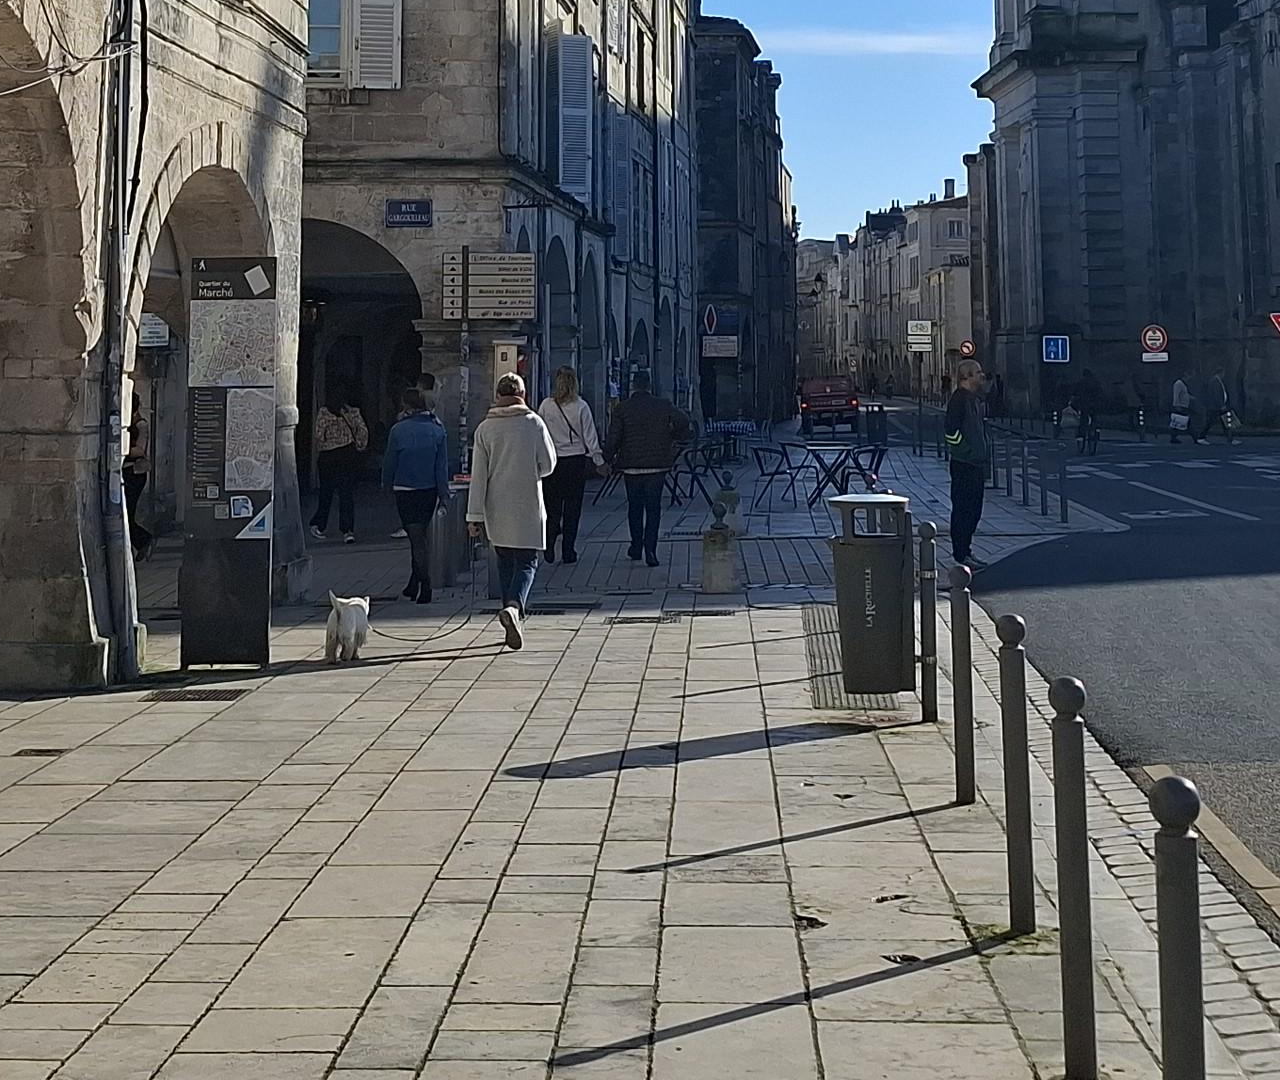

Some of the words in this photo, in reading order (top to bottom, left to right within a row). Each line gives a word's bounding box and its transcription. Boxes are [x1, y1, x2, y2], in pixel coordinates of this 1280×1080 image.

[401, 203, 417, 212] RUE
[198, 287, 234, 297] Marché
[865, 616, 873, 627] LA
